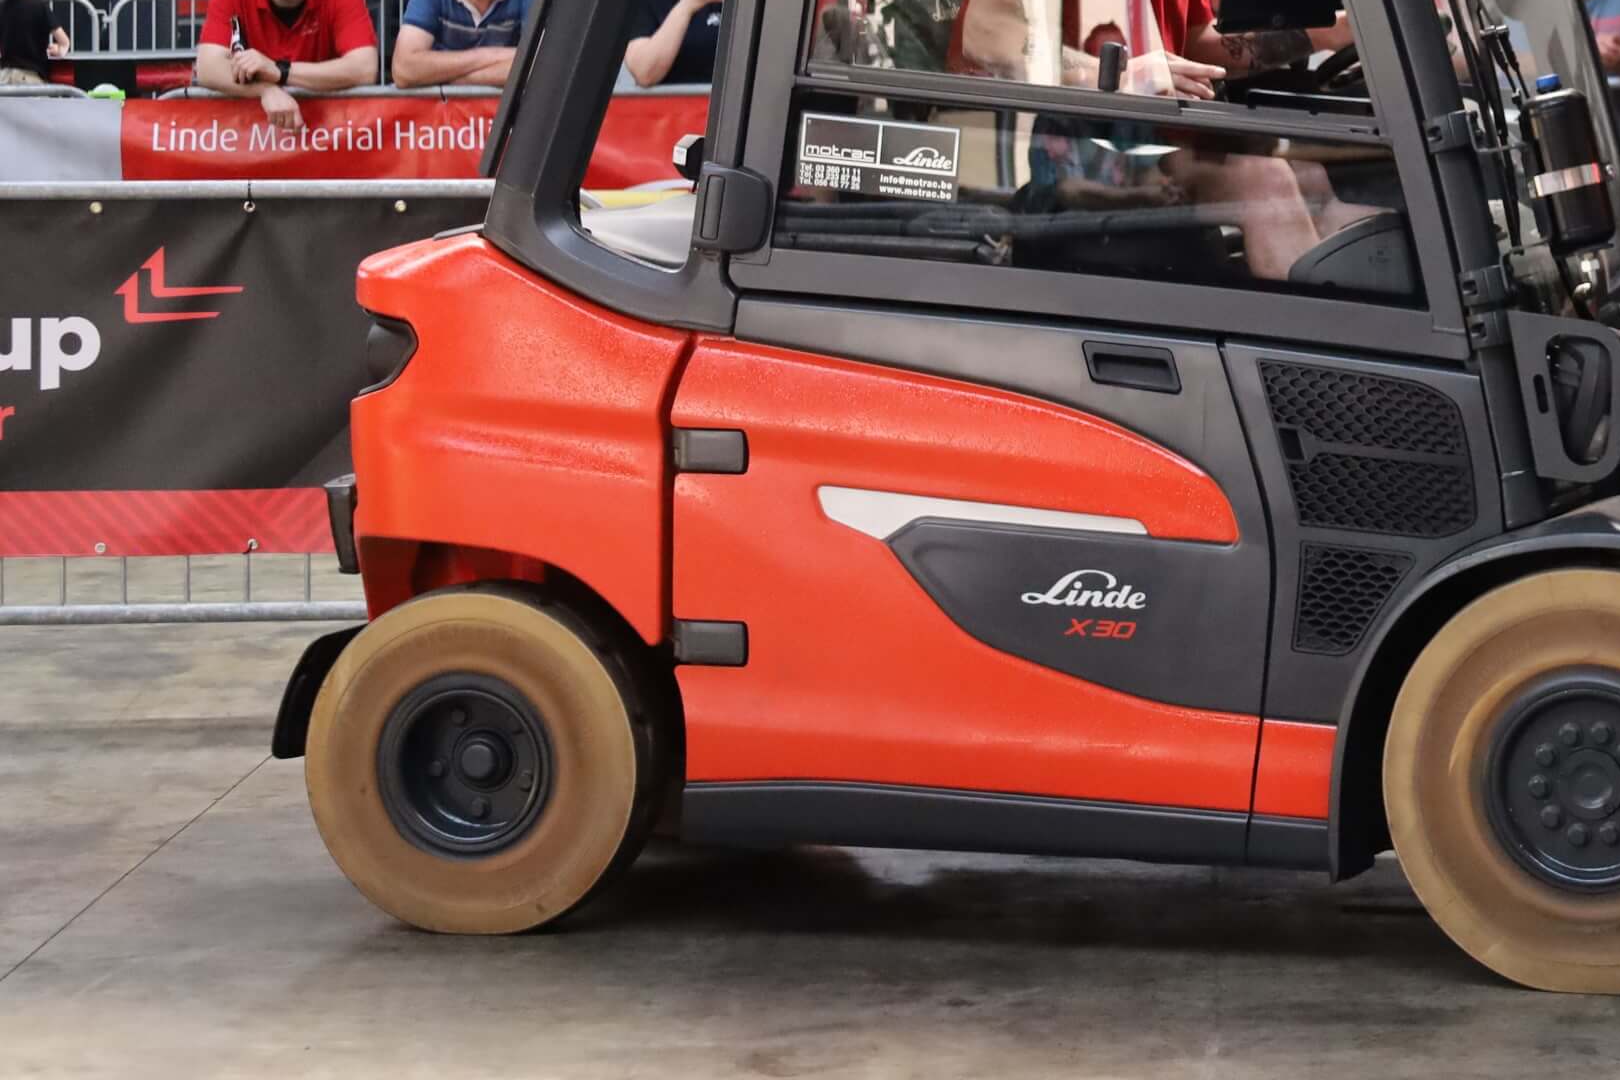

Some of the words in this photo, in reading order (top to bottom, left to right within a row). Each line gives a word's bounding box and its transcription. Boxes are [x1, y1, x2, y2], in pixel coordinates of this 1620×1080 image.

[152, 119, 238, 152] Linde
[249, 117, 383, 152] Material
[395, 116, 493, 151] Handl
[805, 144, 876, 163] motrac
[892, 146, 953, 170] Linde
[879, 173, 953, 191] info@motrac.be
[879, 185, 952, 200] www.motrac.be
[1021, 569, 1147, 609] Linde
